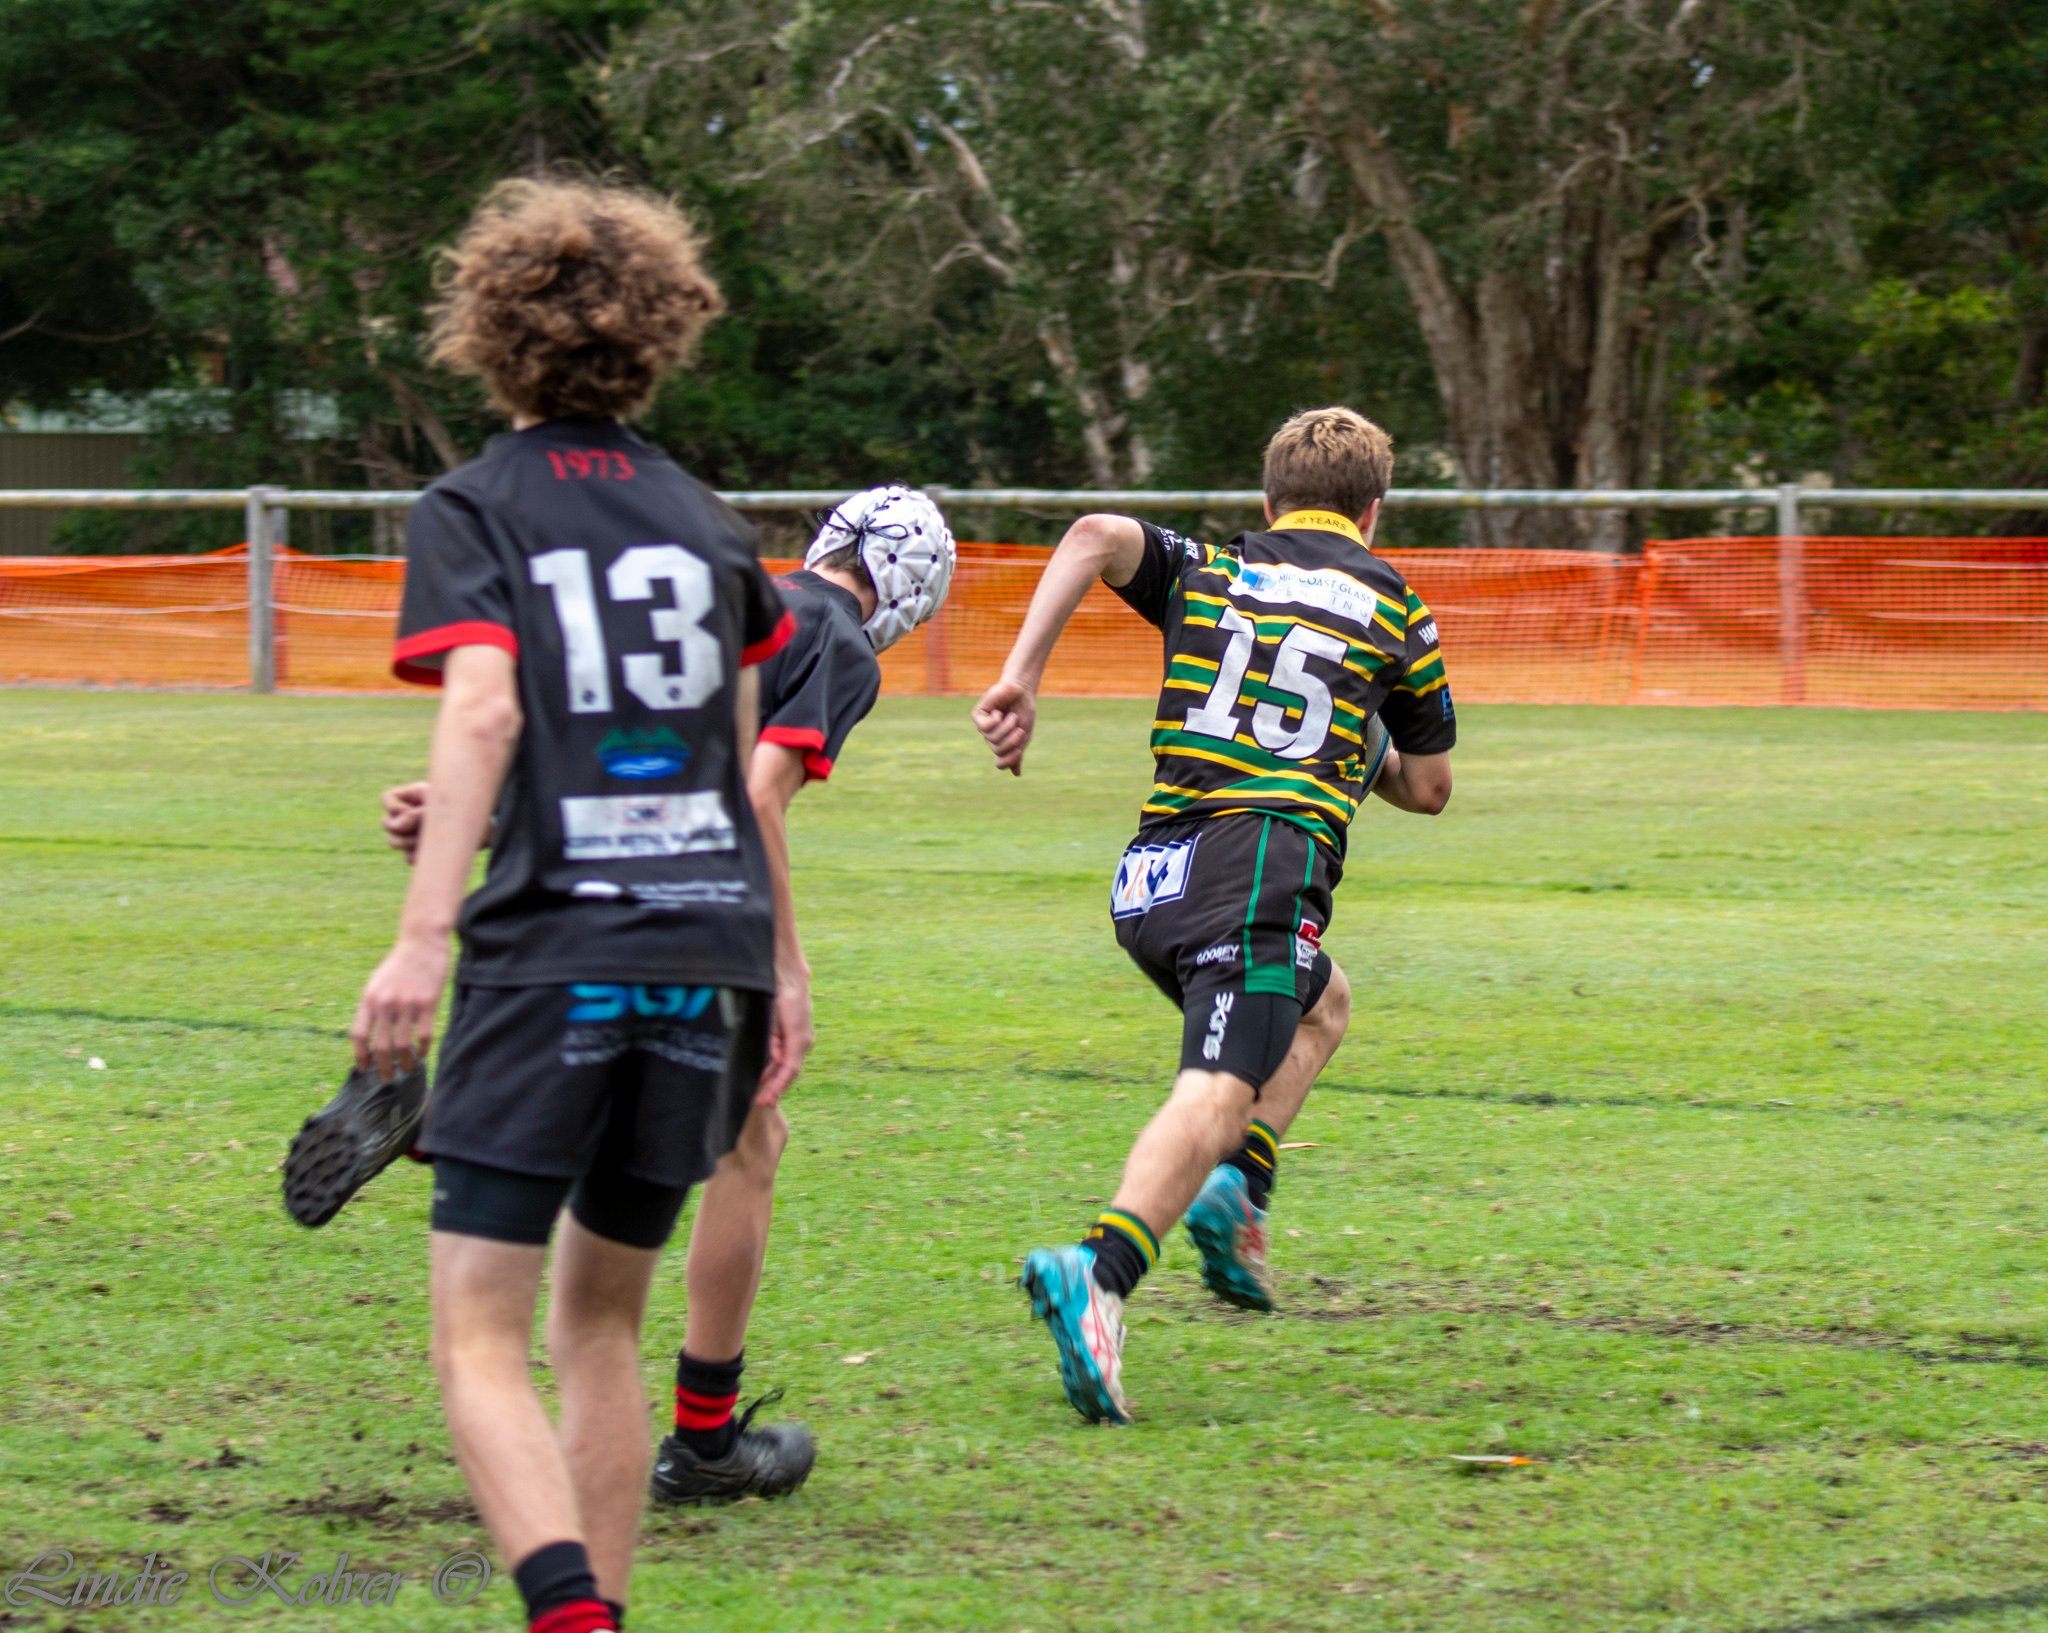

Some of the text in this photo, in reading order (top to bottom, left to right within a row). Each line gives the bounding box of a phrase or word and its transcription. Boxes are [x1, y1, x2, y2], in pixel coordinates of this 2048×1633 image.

[547, 448, 637, 480] 1973
[1308, 516, 1348, 532] YEARS
[1338, 583, 1373, 606] GLASS
[529, 543, 725, 714] 13
[1182, 605, 1348, 760] 15
